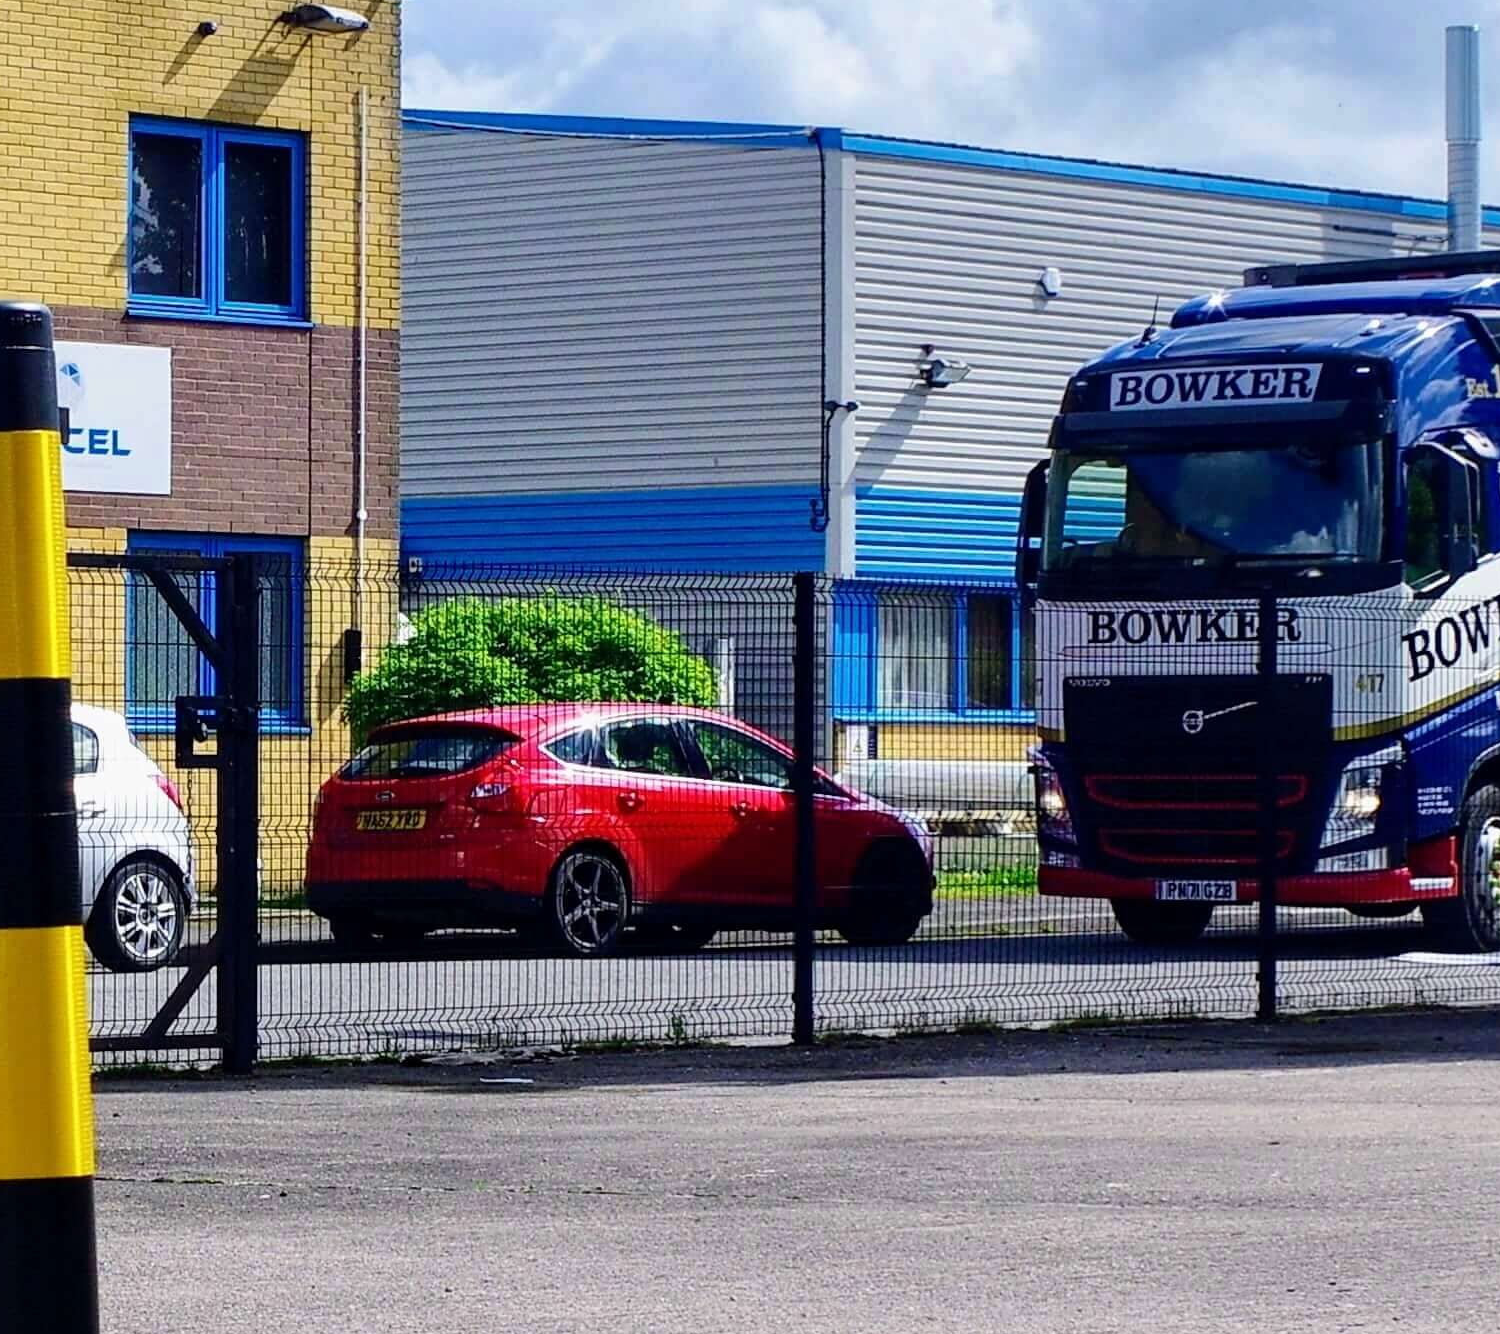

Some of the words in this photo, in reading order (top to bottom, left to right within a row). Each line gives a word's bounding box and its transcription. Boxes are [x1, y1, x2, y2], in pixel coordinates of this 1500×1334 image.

[1114, 367, 1315, 407] BOWKER
[63, 428, 132, 456] CEL
[1087, 608, 1302, 644] BOWKER
